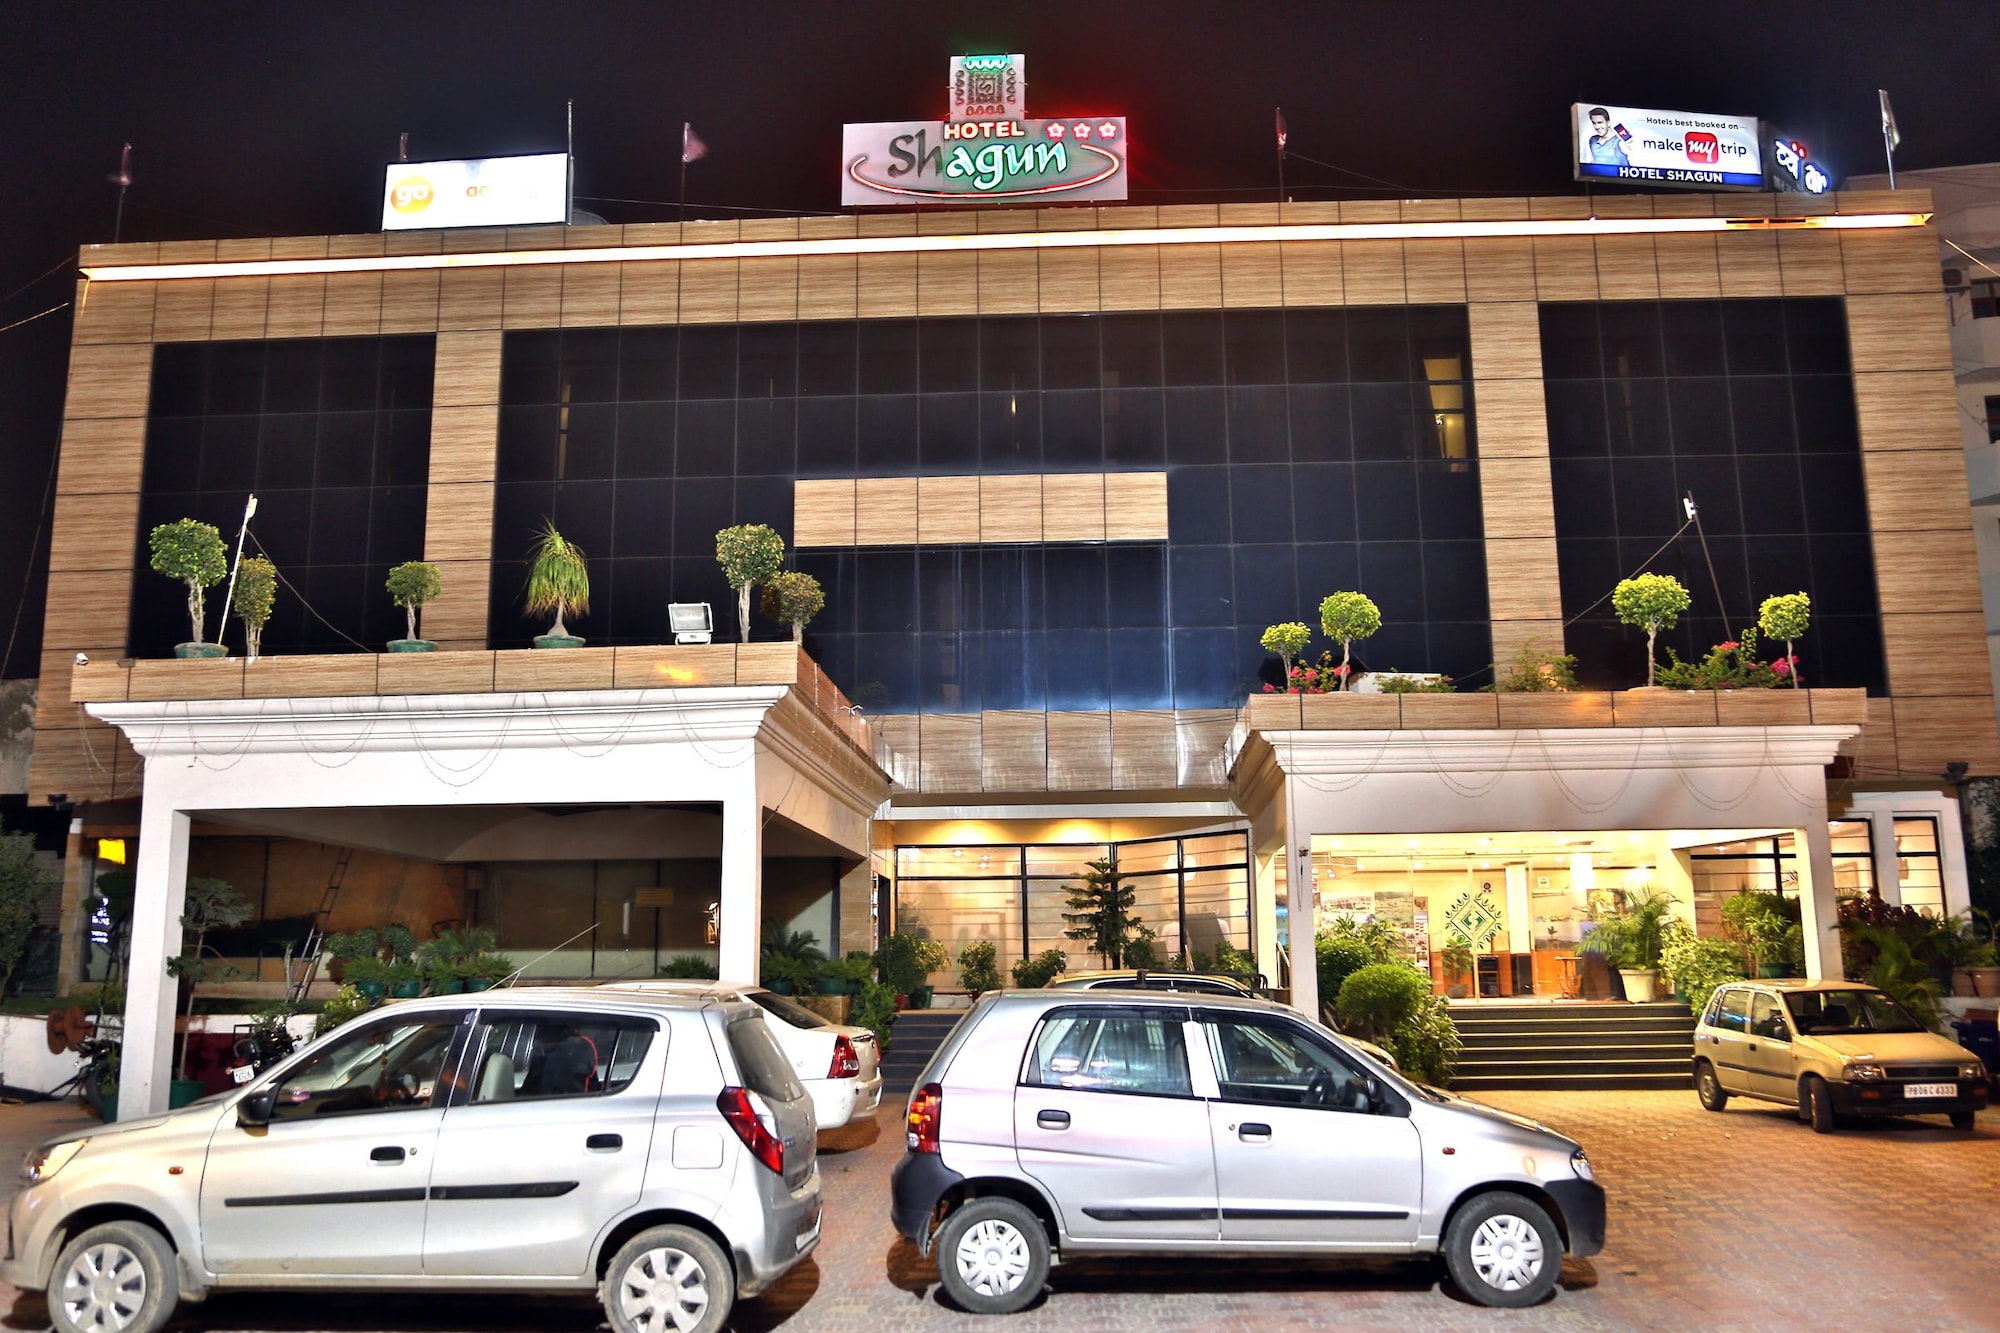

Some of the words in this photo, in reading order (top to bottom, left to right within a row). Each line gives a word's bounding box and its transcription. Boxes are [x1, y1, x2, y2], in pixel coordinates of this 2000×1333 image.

[944, 121, 1025, 139] HOTEL
[1646, 117, 1673, 126] Hotels
[1675, 119, 1693, 127] best
[1695, 120, 1726, 129] booked
[887, 129, 1067, 190] Shagun
[1643, 138, 1683, 151] make
[1687, 140, 1716, 162] my
[1720, 142, 1747, 157] trip
[1619, 166, 1664, 180] HOTEL
[1666, 170, 1723, 183] SHAGUN
[395, 183, 430, 207] go
